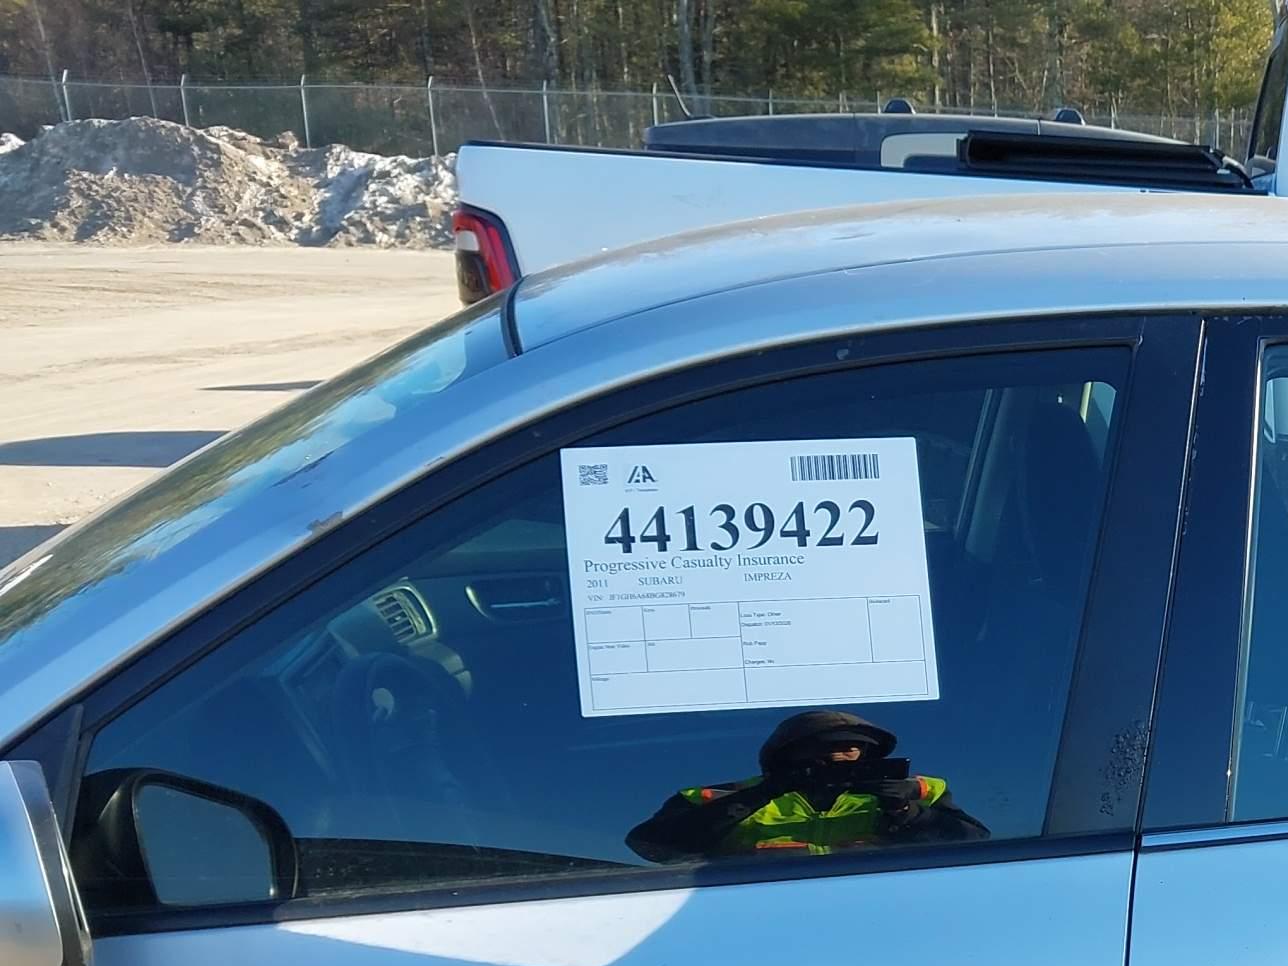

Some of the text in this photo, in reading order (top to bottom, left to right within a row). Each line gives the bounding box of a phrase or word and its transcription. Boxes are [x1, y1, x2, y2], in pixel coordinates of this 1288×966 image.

[604, 499, 879, 554] 44139422
[583, 553, 805, 575] Progressive Casualty Insurance
[587, 572, 793, 589] 2011 SUBARU IMPREZA
